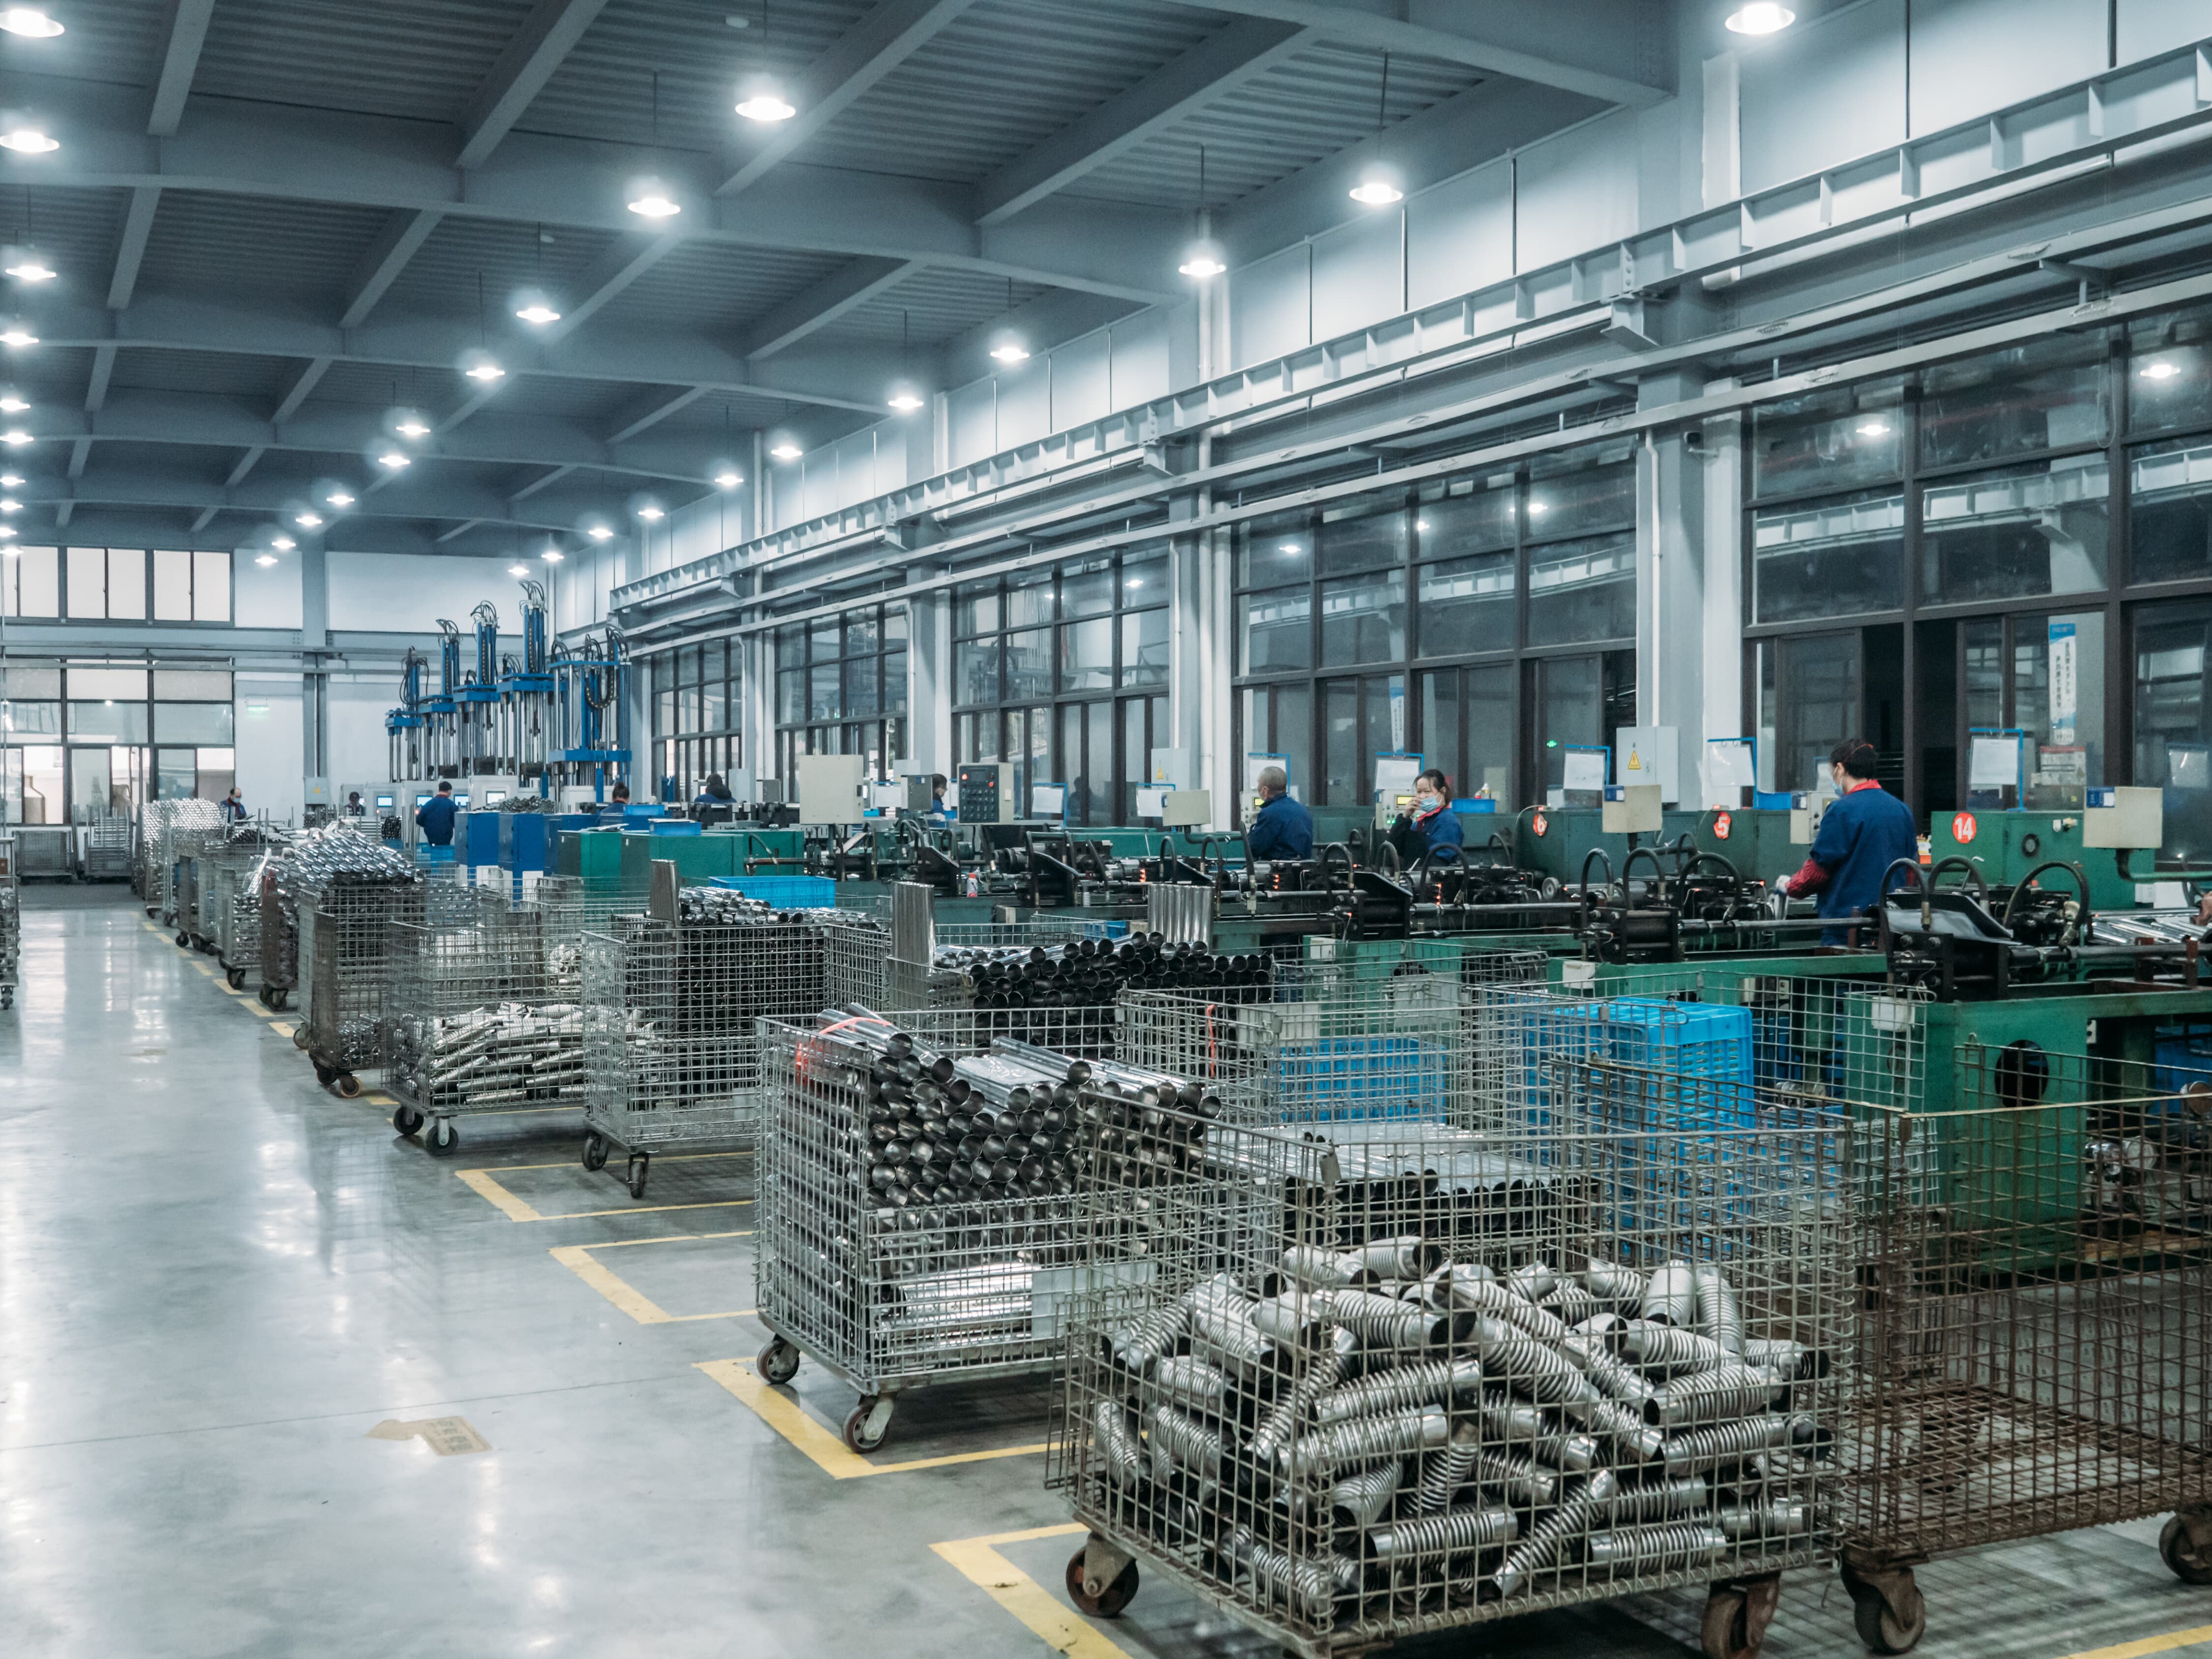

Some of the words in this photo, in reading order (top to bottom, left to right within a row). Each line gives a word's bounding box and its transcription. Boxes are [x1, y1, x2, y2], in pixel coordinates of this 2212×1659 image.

[1537, 815, 1545, 832] 6
[1718, 816, 1729, 836] 5
[1955, 817, 1973, 840] 14
